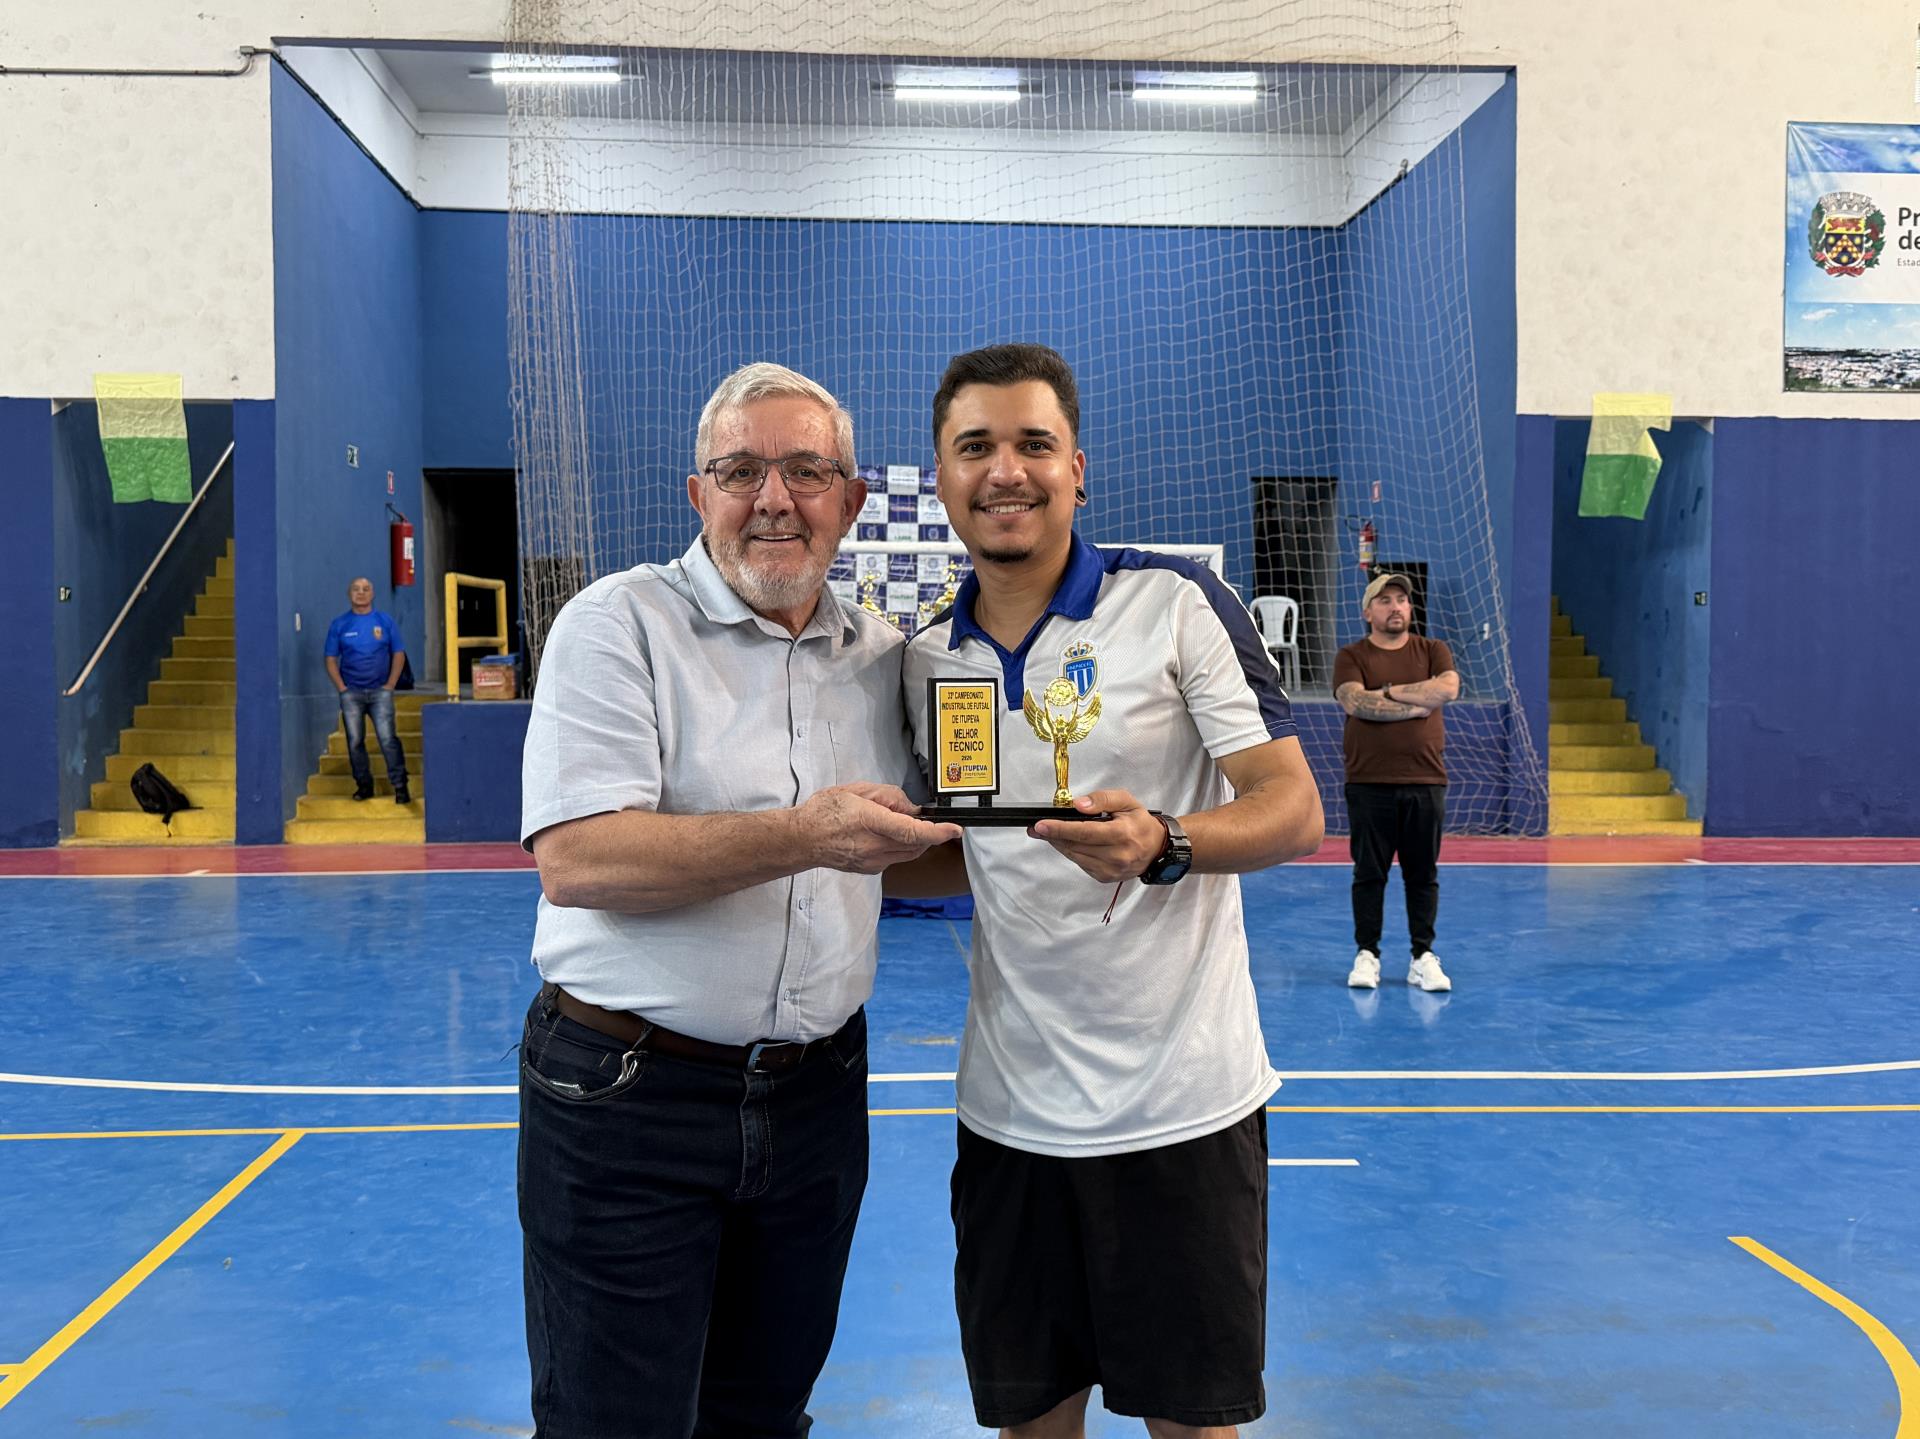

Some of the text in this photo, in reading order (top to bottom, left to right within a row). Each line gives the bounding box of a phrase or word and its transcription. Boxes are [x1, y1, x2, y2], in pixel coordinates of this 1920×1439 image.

[955, 692, 984, 700] CAMPEONATO
[941, 702, 989, 710] INDUSTRIAL DE FUTSAL
[952, 715, 979, 723] DE ITUPEVA
[953, 728, 979, 739] MELHOR
[949, 739, 984, 752] TÉCNICO
